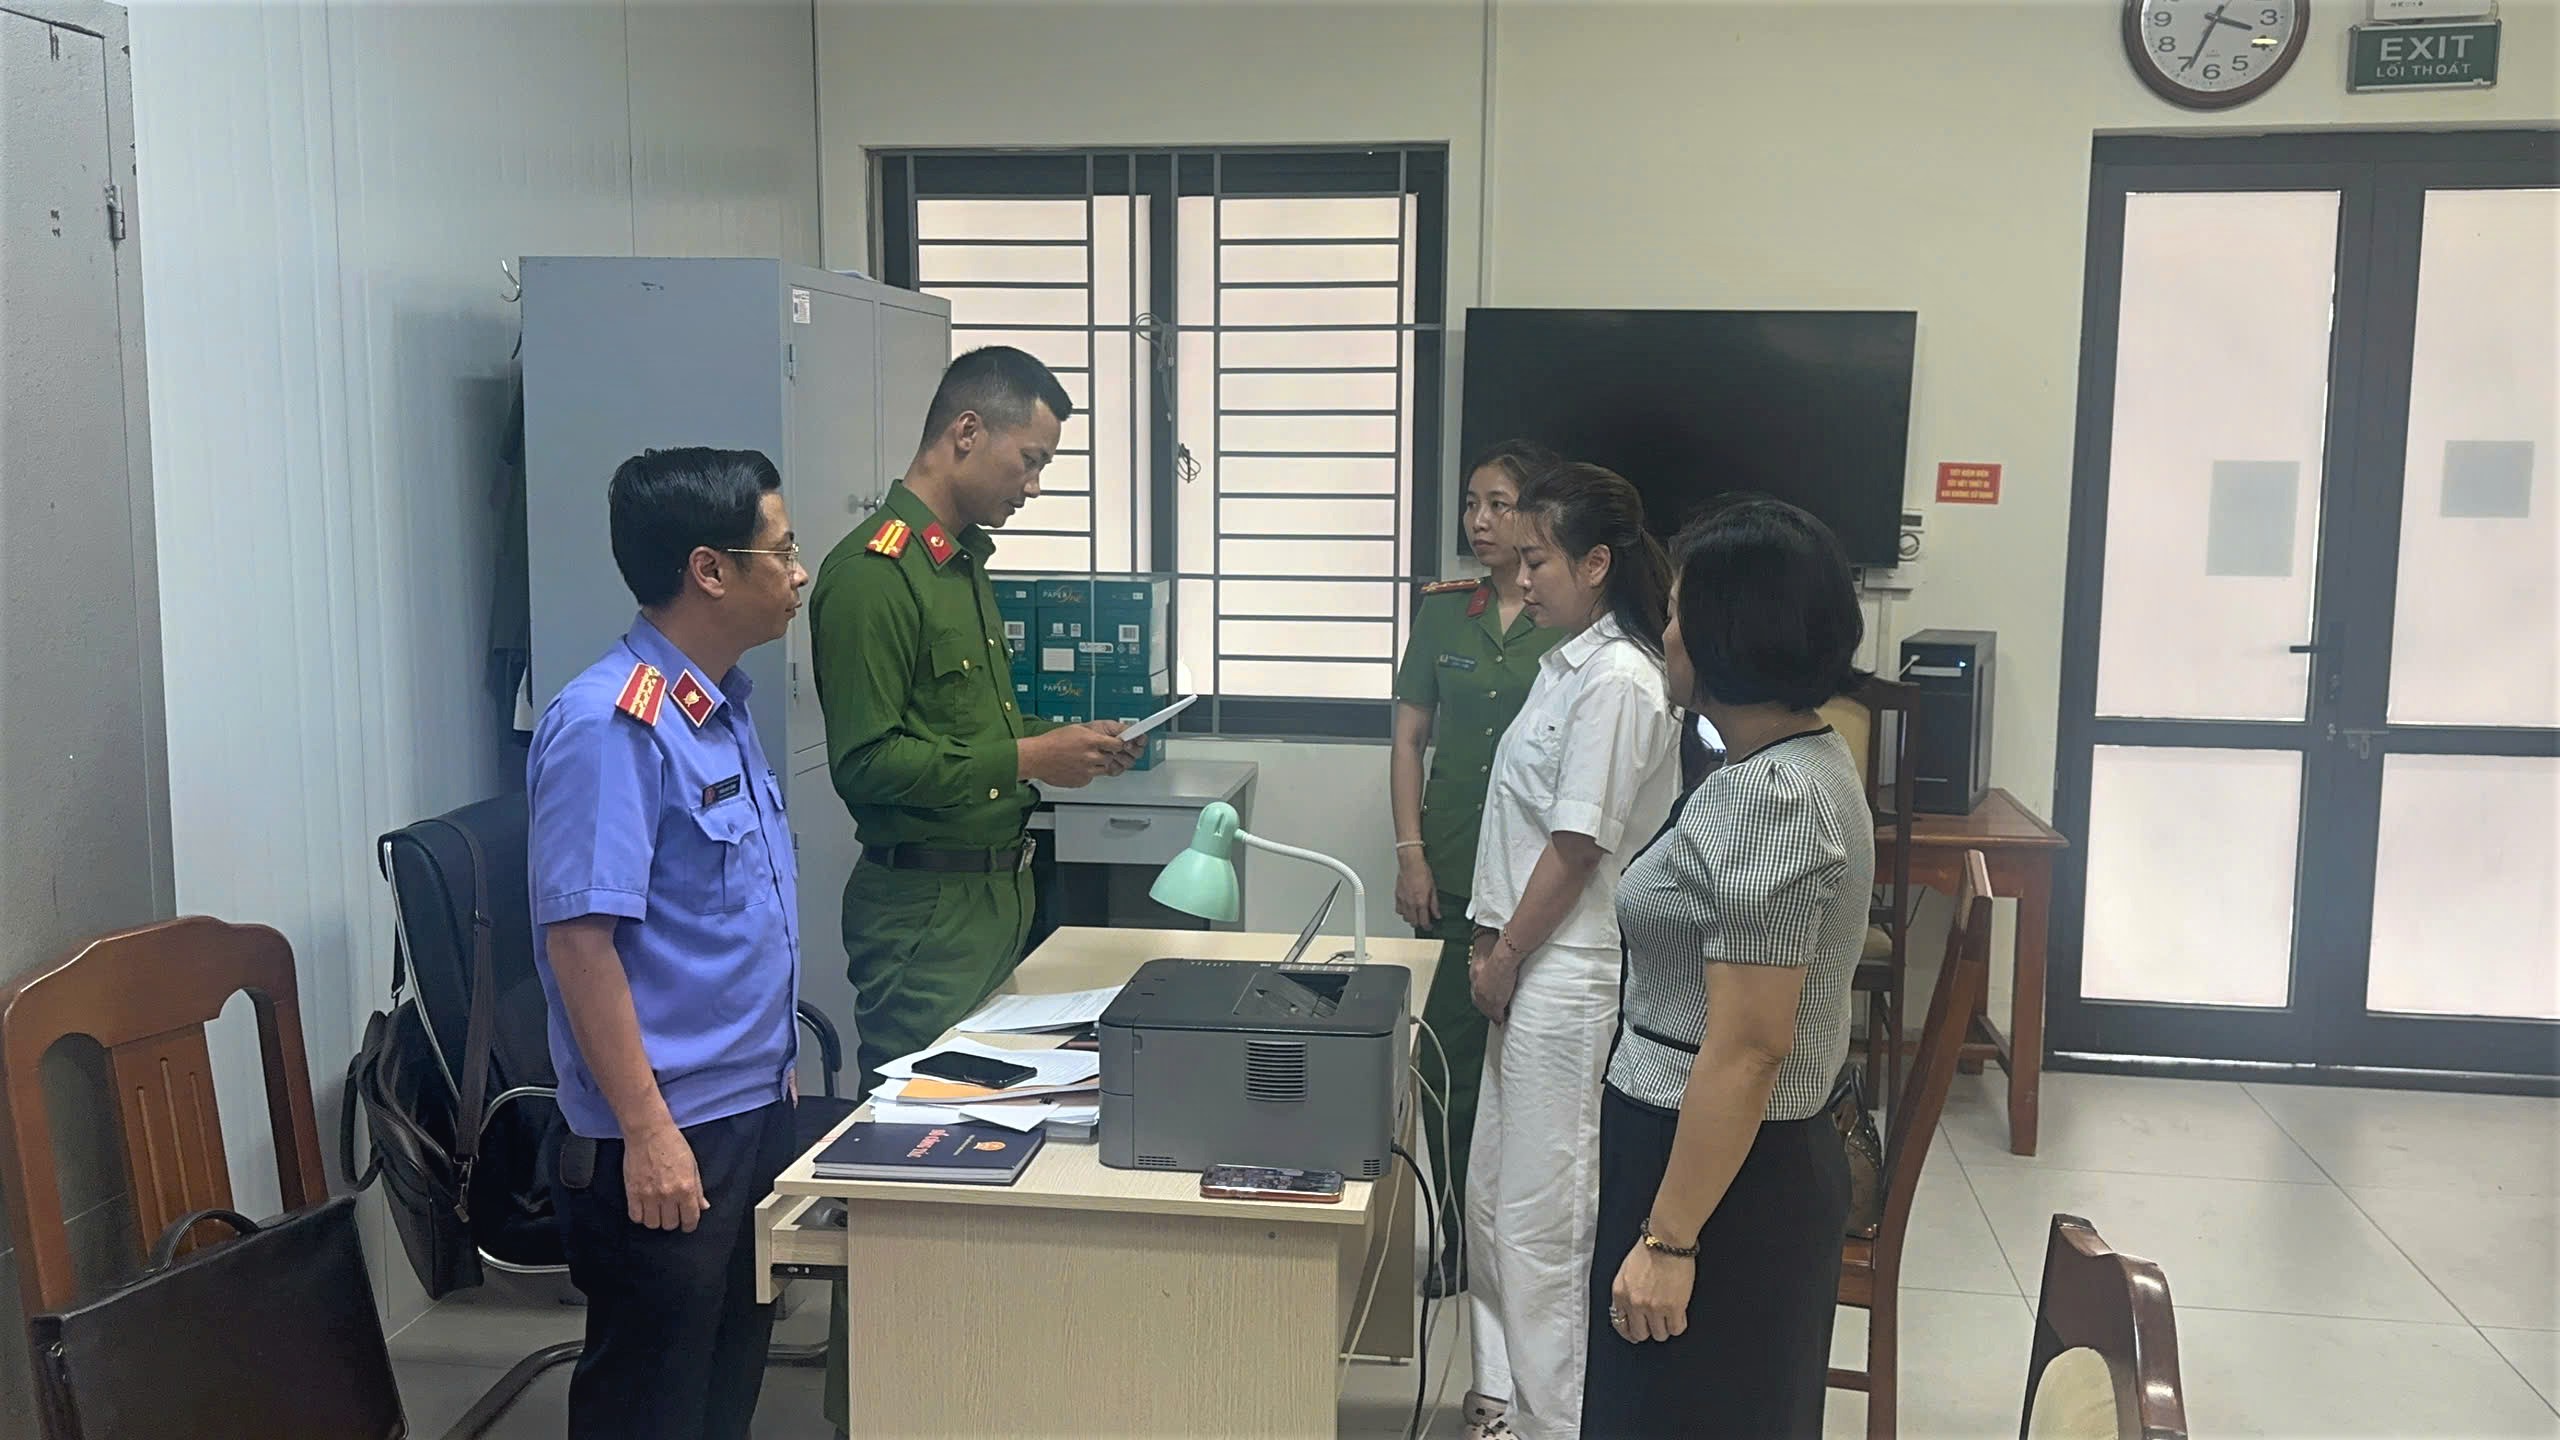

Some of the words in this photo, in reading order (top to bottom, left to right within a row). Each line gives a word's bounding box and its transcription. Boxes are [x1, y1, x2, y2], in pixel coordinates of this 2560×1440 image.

[2154, 11, 2172, 27] 9
[2260, 9, 2278, 26] 3
[2158, 36, 2176, 52] 8
[2380, 35, 2474, 62] EXIT
[2177, 56, 2193, 72] 7
[2231, 55, 2249, 71] 5
[2411, 62, 2472, 76] THOÁT
[2202, 64, 2221, 80] 6
[1042, 591, 1068, 599] PAPER
[1042, 683, 1068, 692] PAPER
